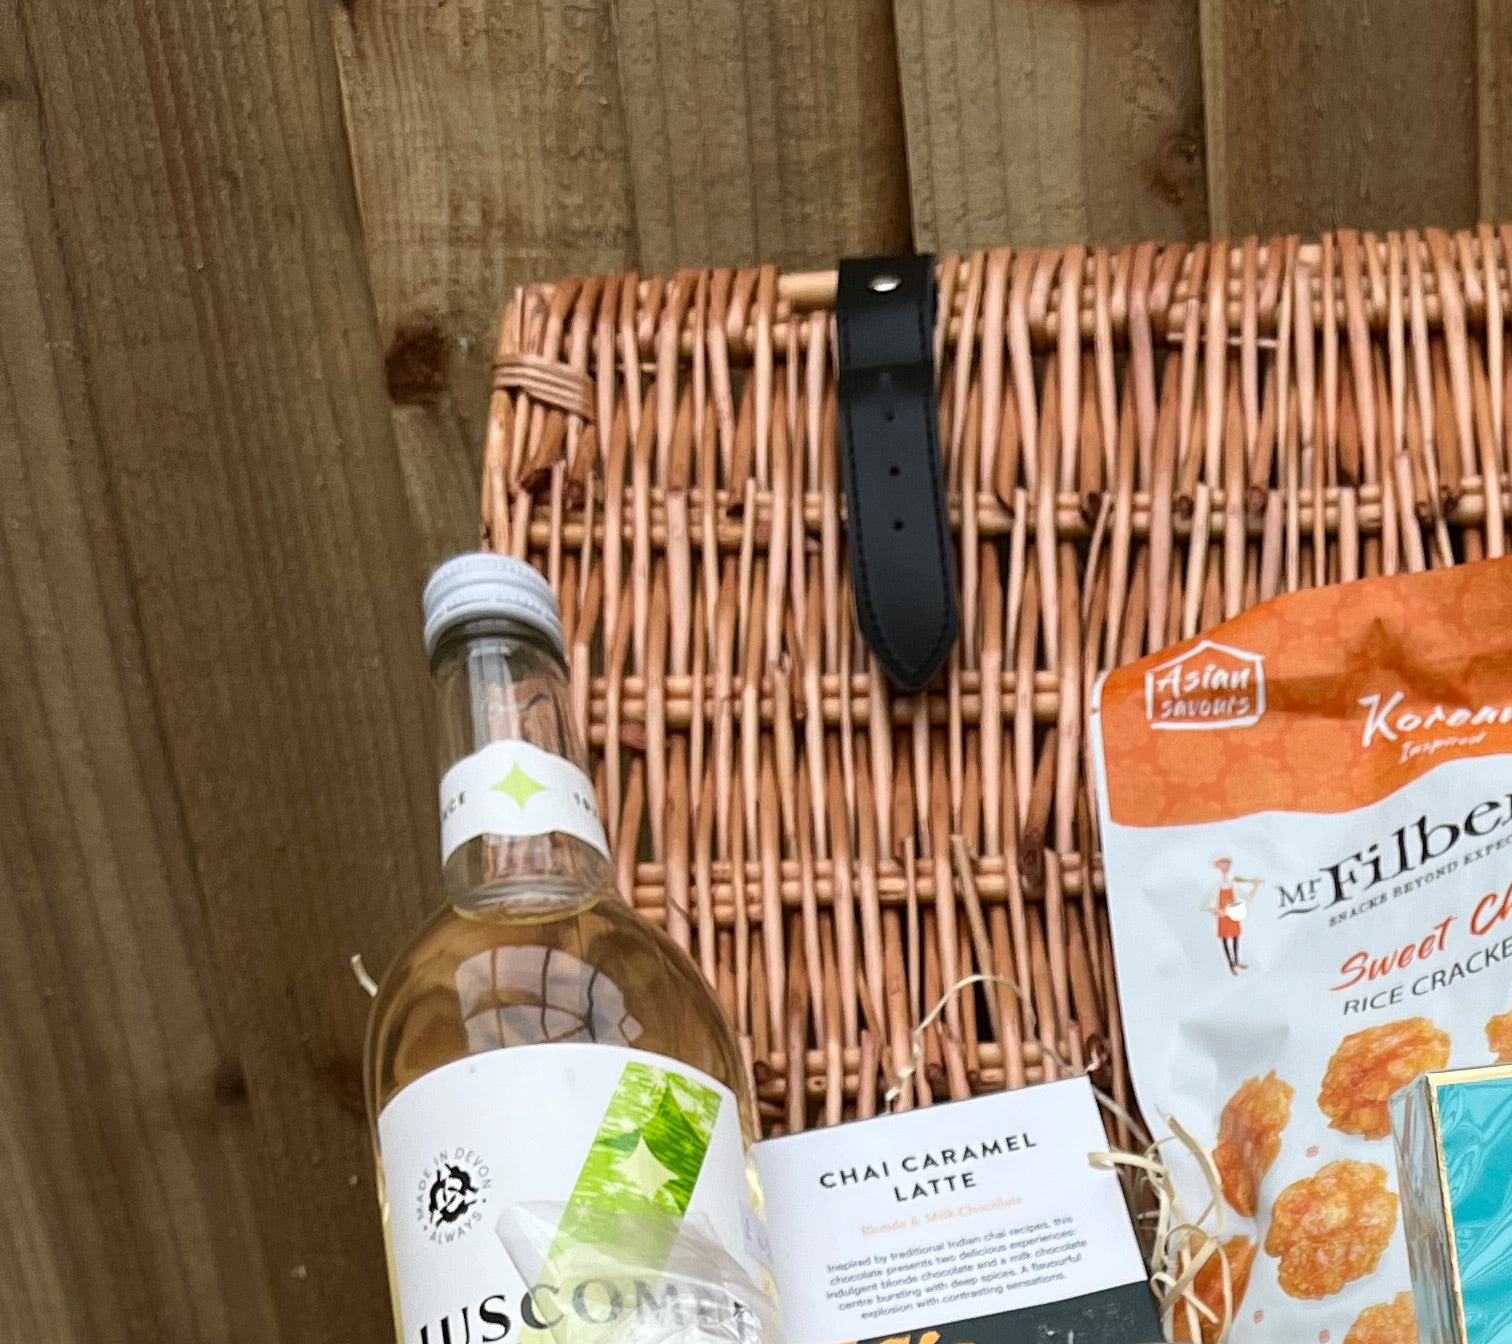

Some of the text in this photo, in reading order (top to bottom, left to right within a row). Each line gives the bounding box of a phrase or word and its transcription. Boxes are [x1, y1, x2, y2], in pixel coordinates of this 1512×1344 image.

[1156, 664, 1251, 698] Asian
[1275, 877, 1321, 909] Mr
[1328, 891, 1388, 928] SNACKS
[1392, 860, 1459, 898] BEYOND
[1330, 915, 1457, 991] Sweet
[1343, 990, 1404, 1016] RICE
[819, 1132, 1037, 1189] CHAI CARAMEL
[893, 1171, 977, 1203] LATTE
